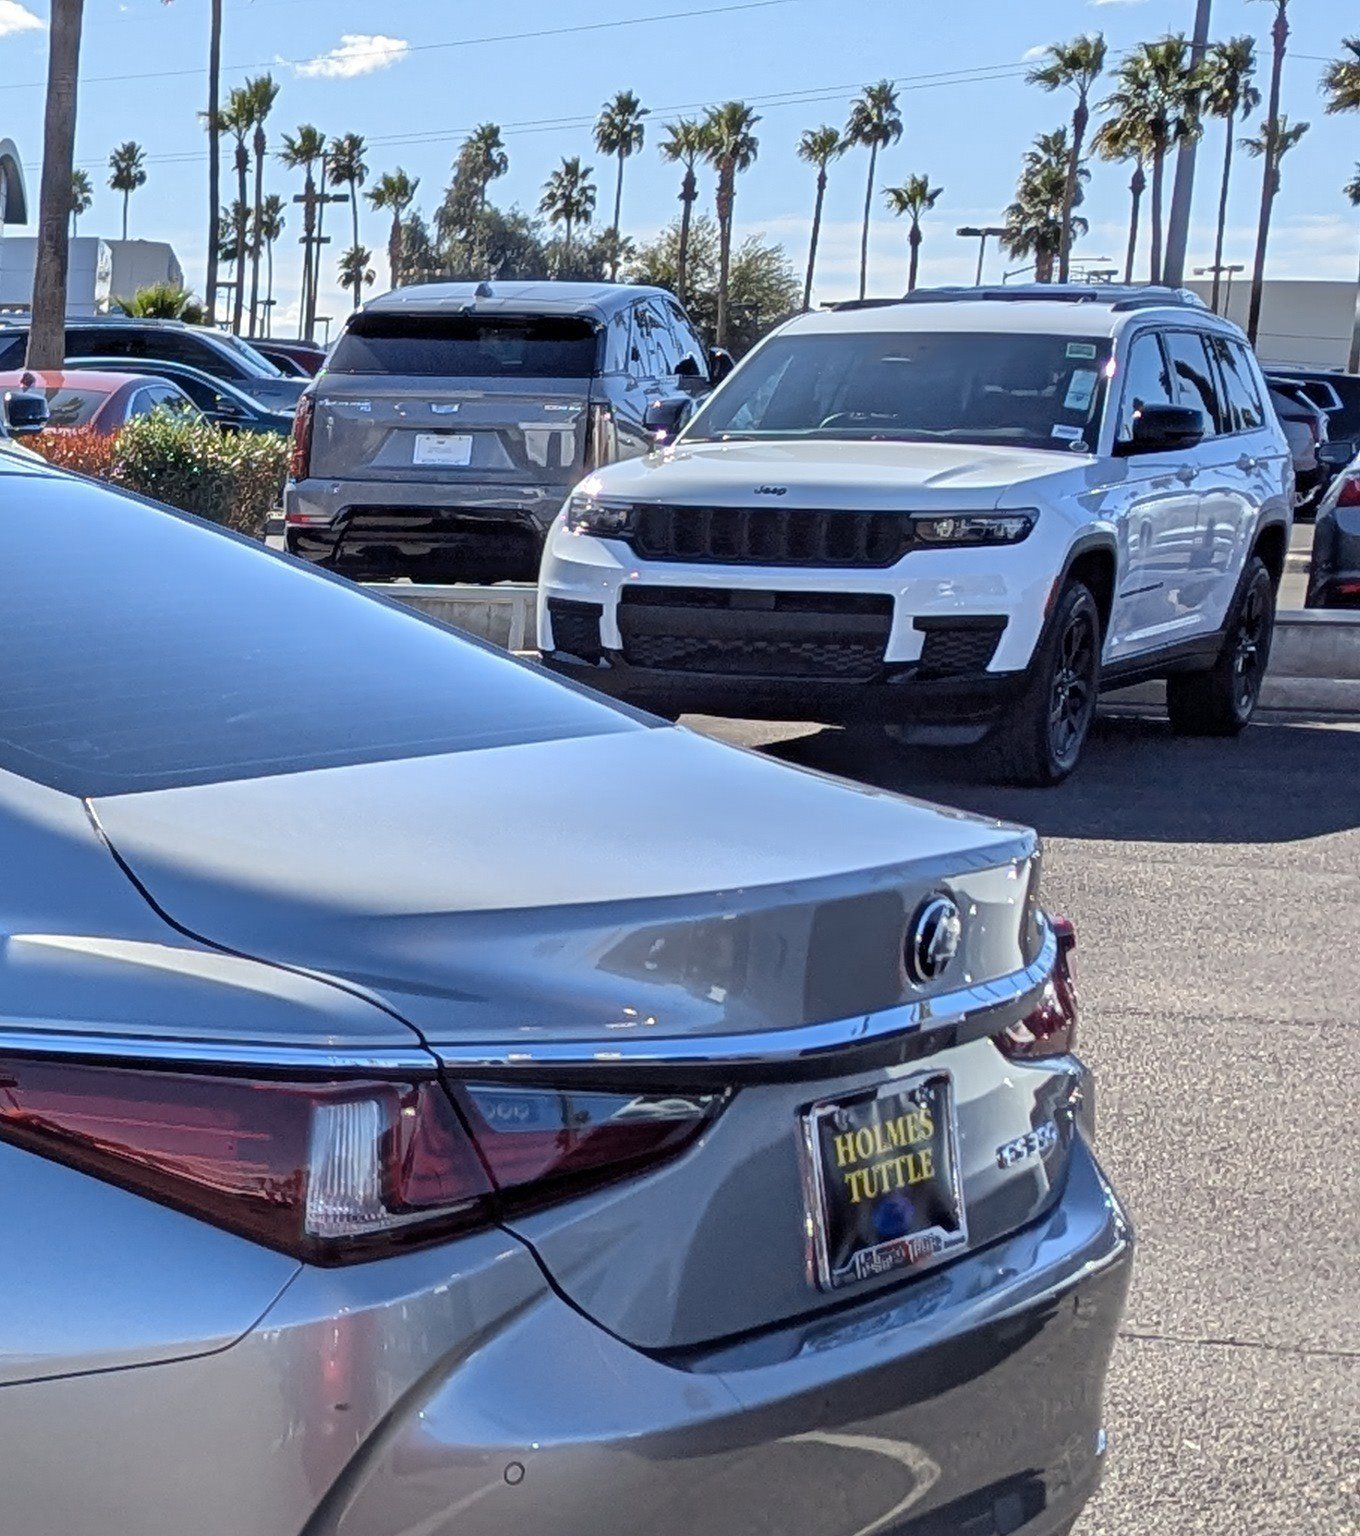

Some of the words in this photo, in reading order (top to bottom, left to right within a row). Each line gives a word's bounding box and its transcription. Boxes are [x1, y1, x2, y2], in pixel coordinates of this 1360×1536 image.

[753, 484, 787, 496] Jeep
[833, 1109, 935, 1168] HOLMES
[843, 1148, 936, 1204] TUTTLE
